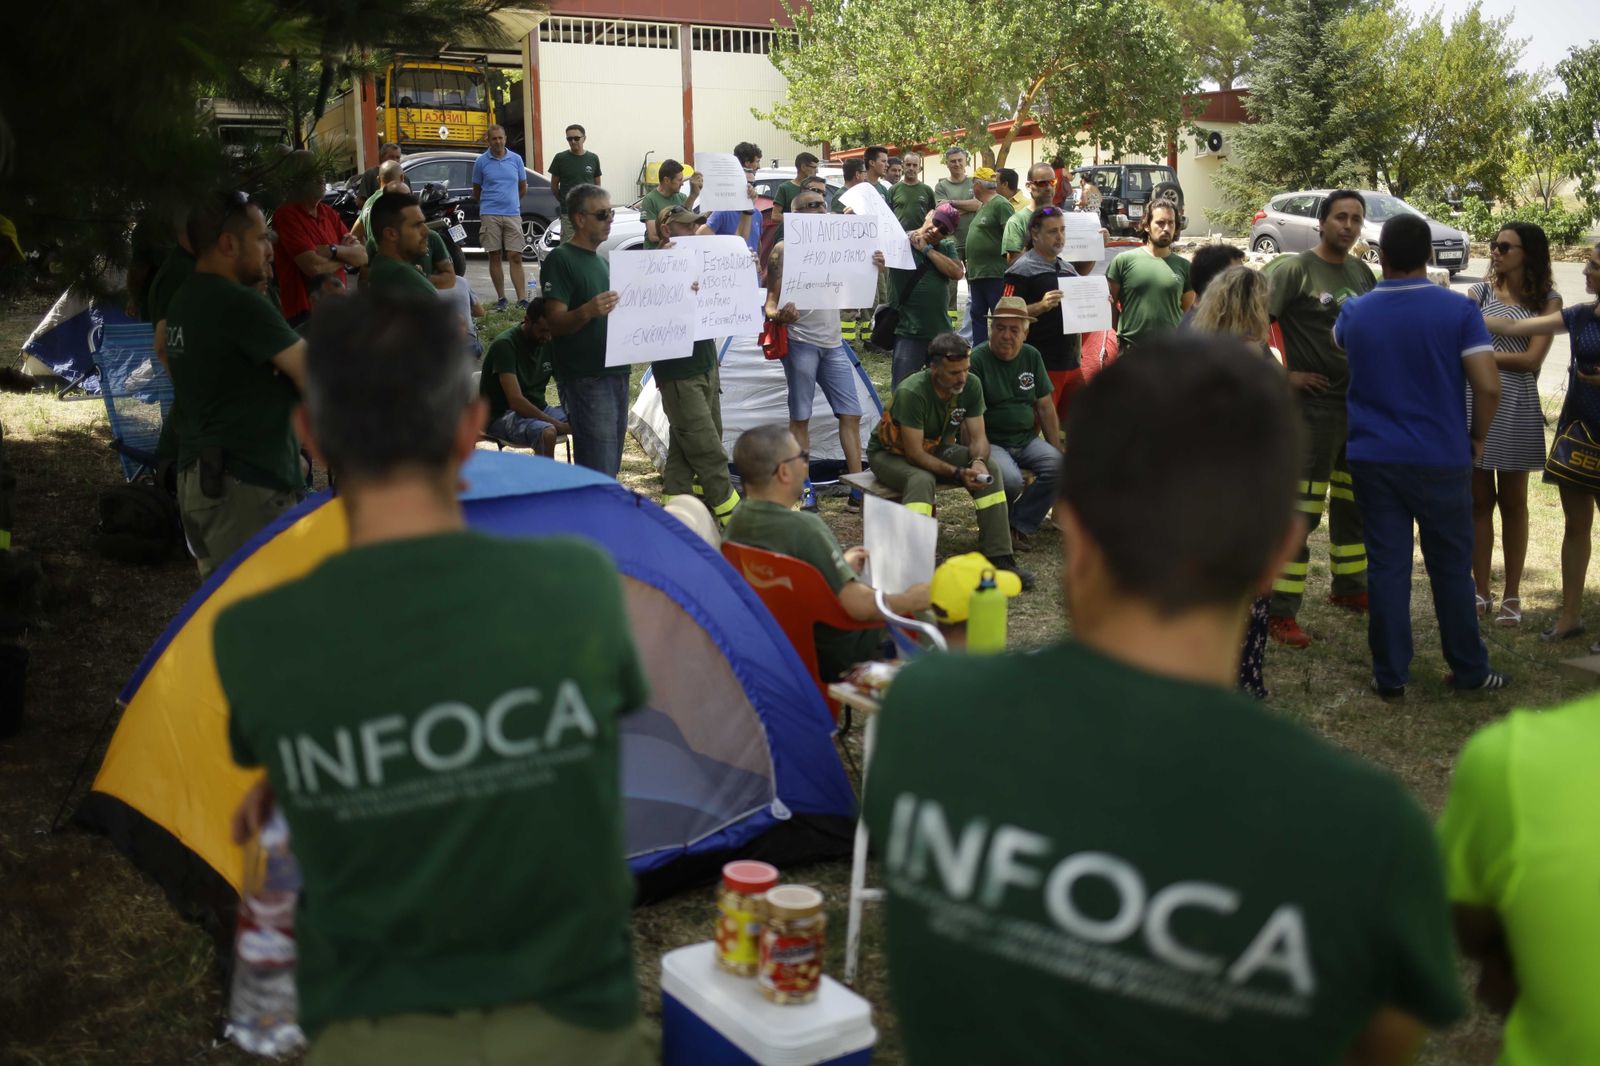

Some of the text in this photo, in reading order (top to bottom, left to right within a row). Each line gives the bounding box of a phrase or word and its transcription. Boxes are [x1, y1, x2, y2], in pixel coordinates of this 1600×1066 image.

[791, 218, 878, 245] SIN ANTIGUEDAD
[829, 250, 842, 265] NO
[844, 249, 867, 264] FIRMO
[277, 679, 597, 793] INFOCA
[885, 792, 1316, 996] INFOCA
